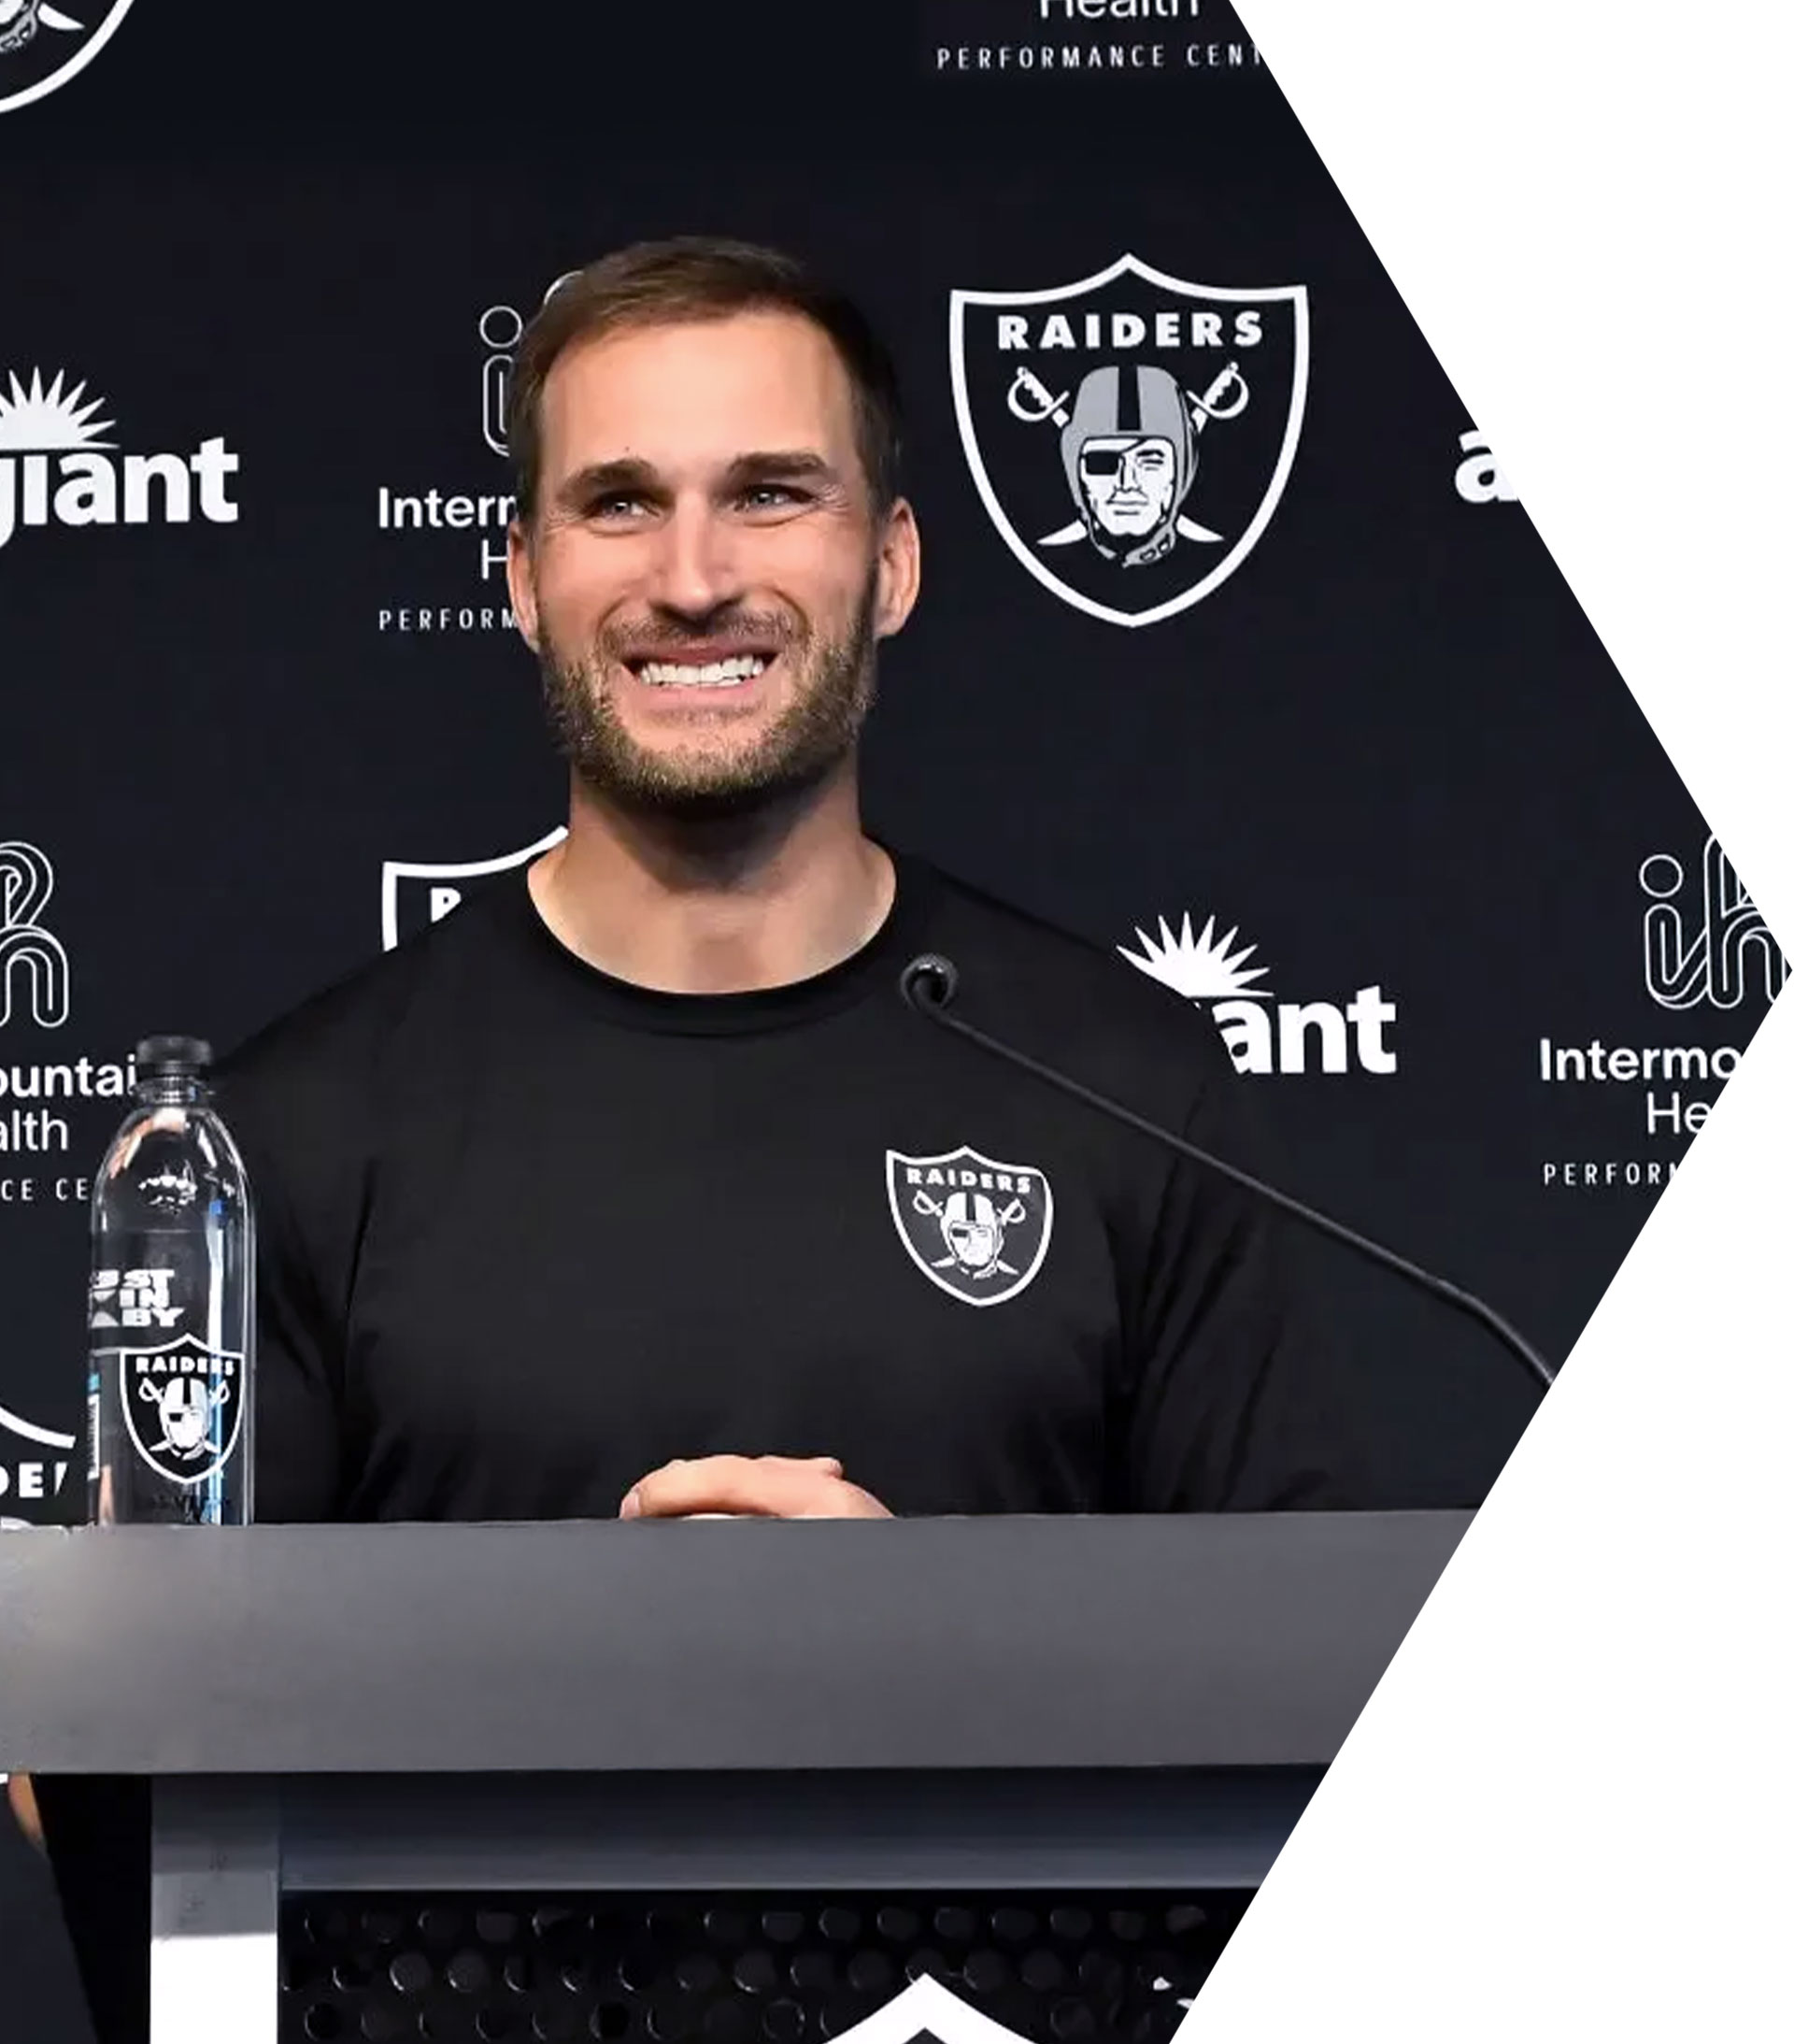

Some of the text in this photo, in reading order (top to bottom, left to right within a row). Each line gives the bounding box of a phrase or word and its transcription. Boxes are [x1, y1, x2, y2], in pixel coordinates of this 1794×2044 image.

[936, 45, 1165, 70] PERFORMANCE
[997, 310, 1263, 350] RAIDERS
[0, 436, 239, 549] iant
[0, 1053, 137, 1098] untai
[1540, 1037, 1743, 1081] Intermo
[906, 1166, 1032, 1194] RAIDERS
